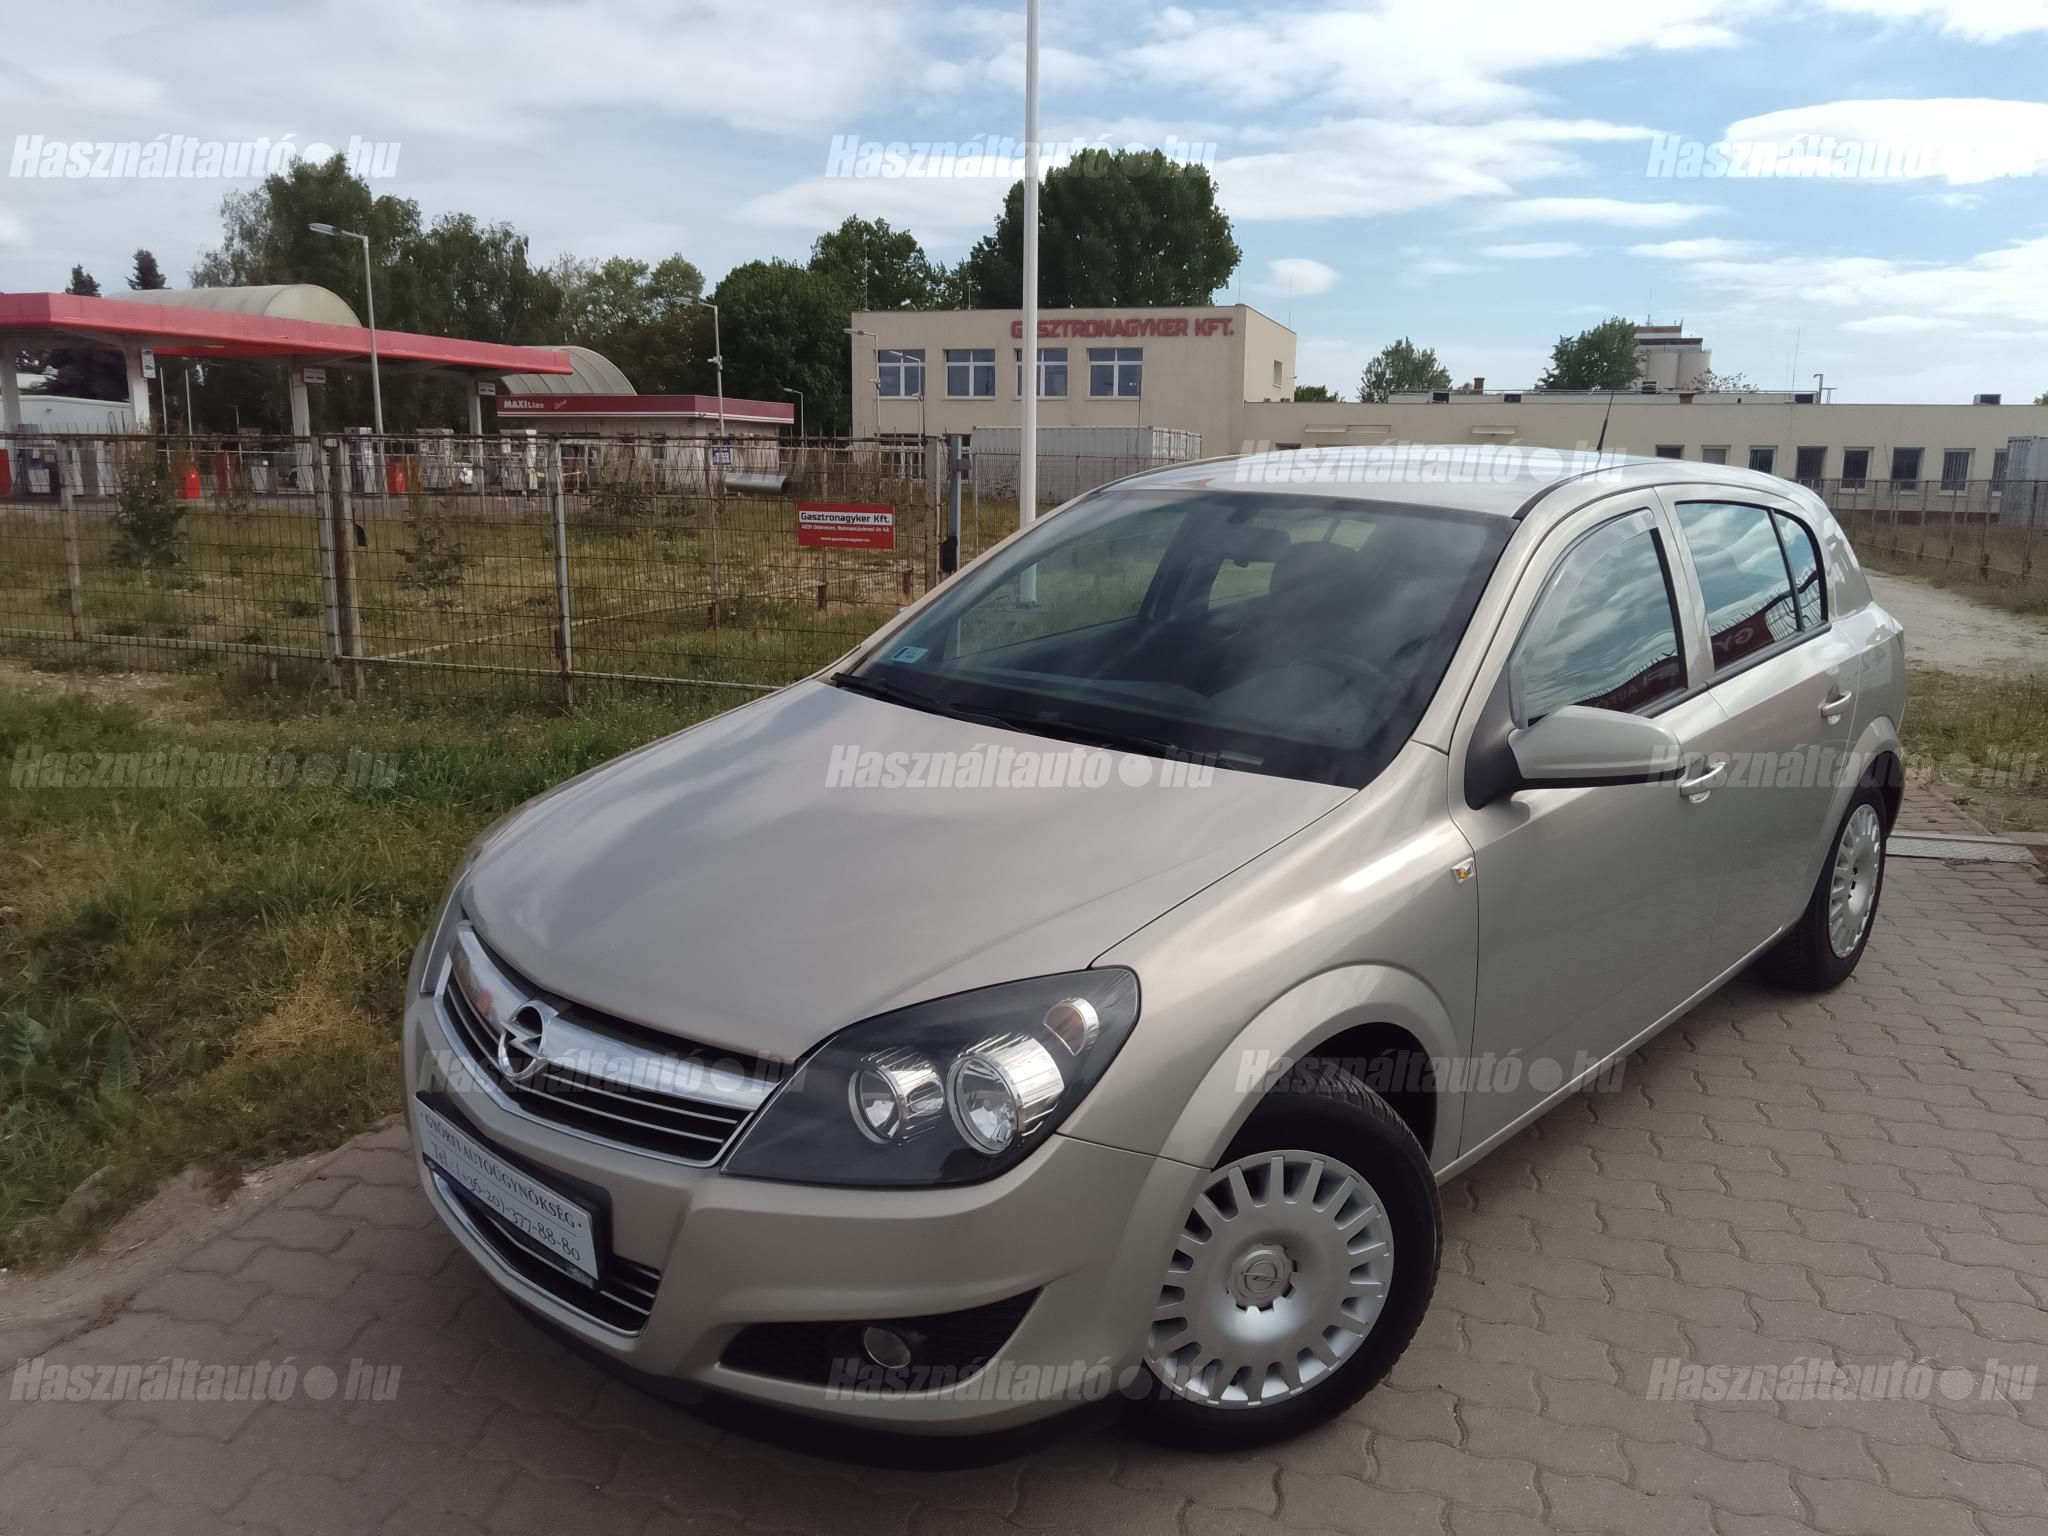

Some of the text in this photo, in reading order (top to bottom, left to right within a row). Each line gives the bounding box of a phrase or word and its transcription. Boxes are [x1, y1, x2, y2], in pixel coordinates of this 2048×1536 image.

[1010, 318, 1234, 339] GSZTRONAGYKER KFT.
[801, 512, 891, 524] Gasztronagyker Kft.
[463, 1144, 575, 1228] AUTÓÜGYNÖKSÉG
